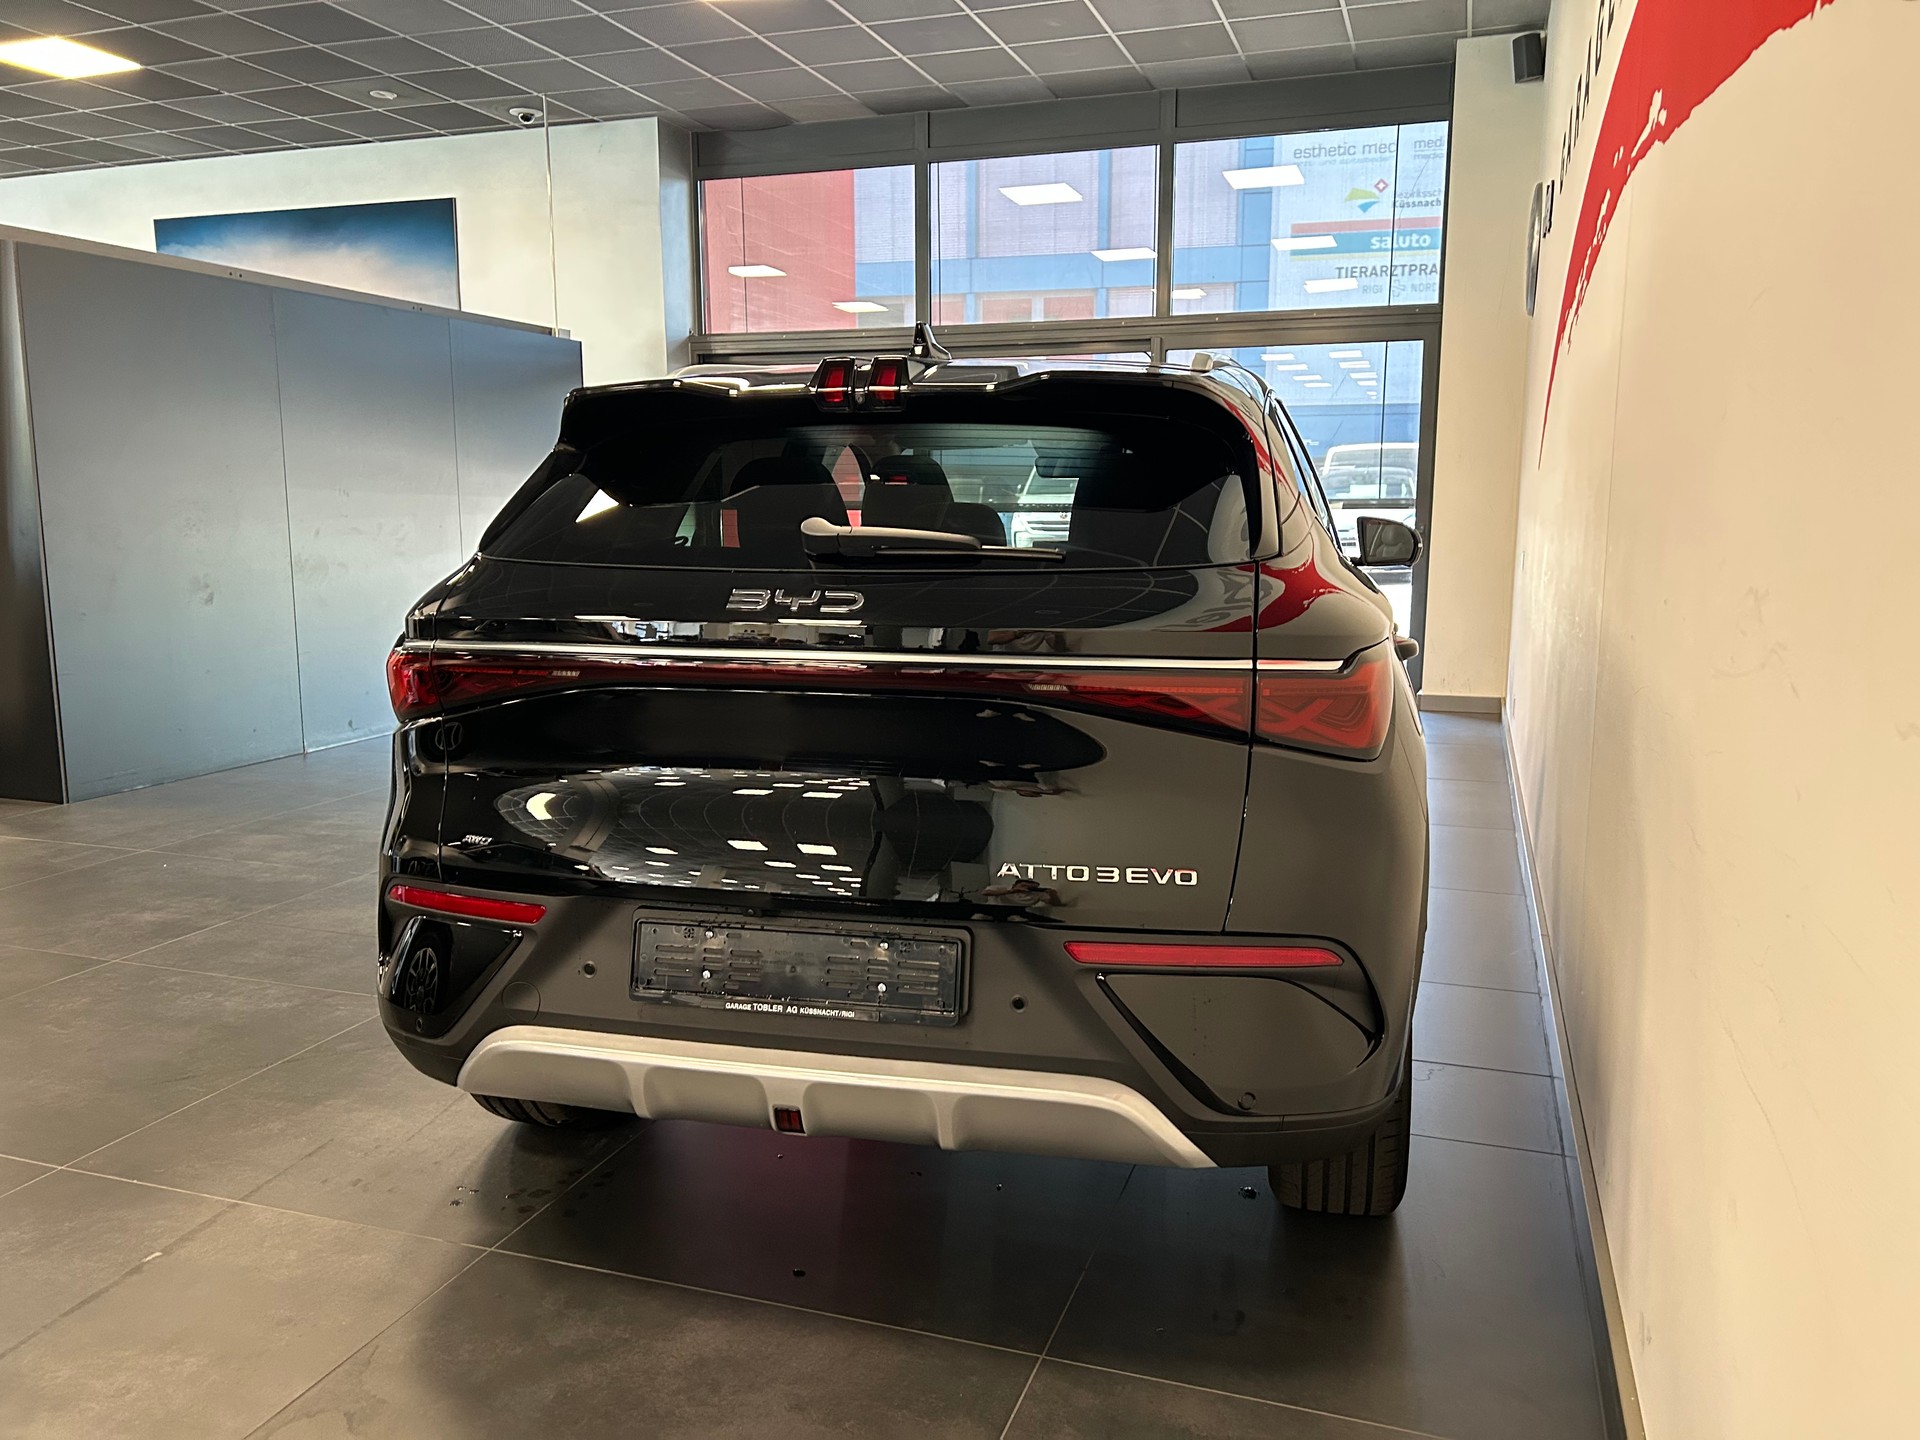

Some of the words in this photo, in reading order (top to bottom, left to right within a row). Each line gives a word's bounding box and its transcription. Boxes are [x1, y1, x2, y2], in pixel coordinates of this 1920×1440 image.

[1293, 141, 1357, 159] esthetic
[1370, 232, 1432, 249] saluto
[1335, 263, 1438, 279] TIERARZTPRA
[726, 588, 865, 612] BYD
[997, 862, 1090, 882] ATTO
[1096, 866, 1120, 884] 3
[1125, 867, 1198, 886] EVO
[725, 1002, 752, 1011] GARAGE
[752, 1003, 783, 1013] TOBLER
[785, 1005, 798, 1014] AG
[799, 1006, 855, 1018] KÜSSNACHT/RIGI
